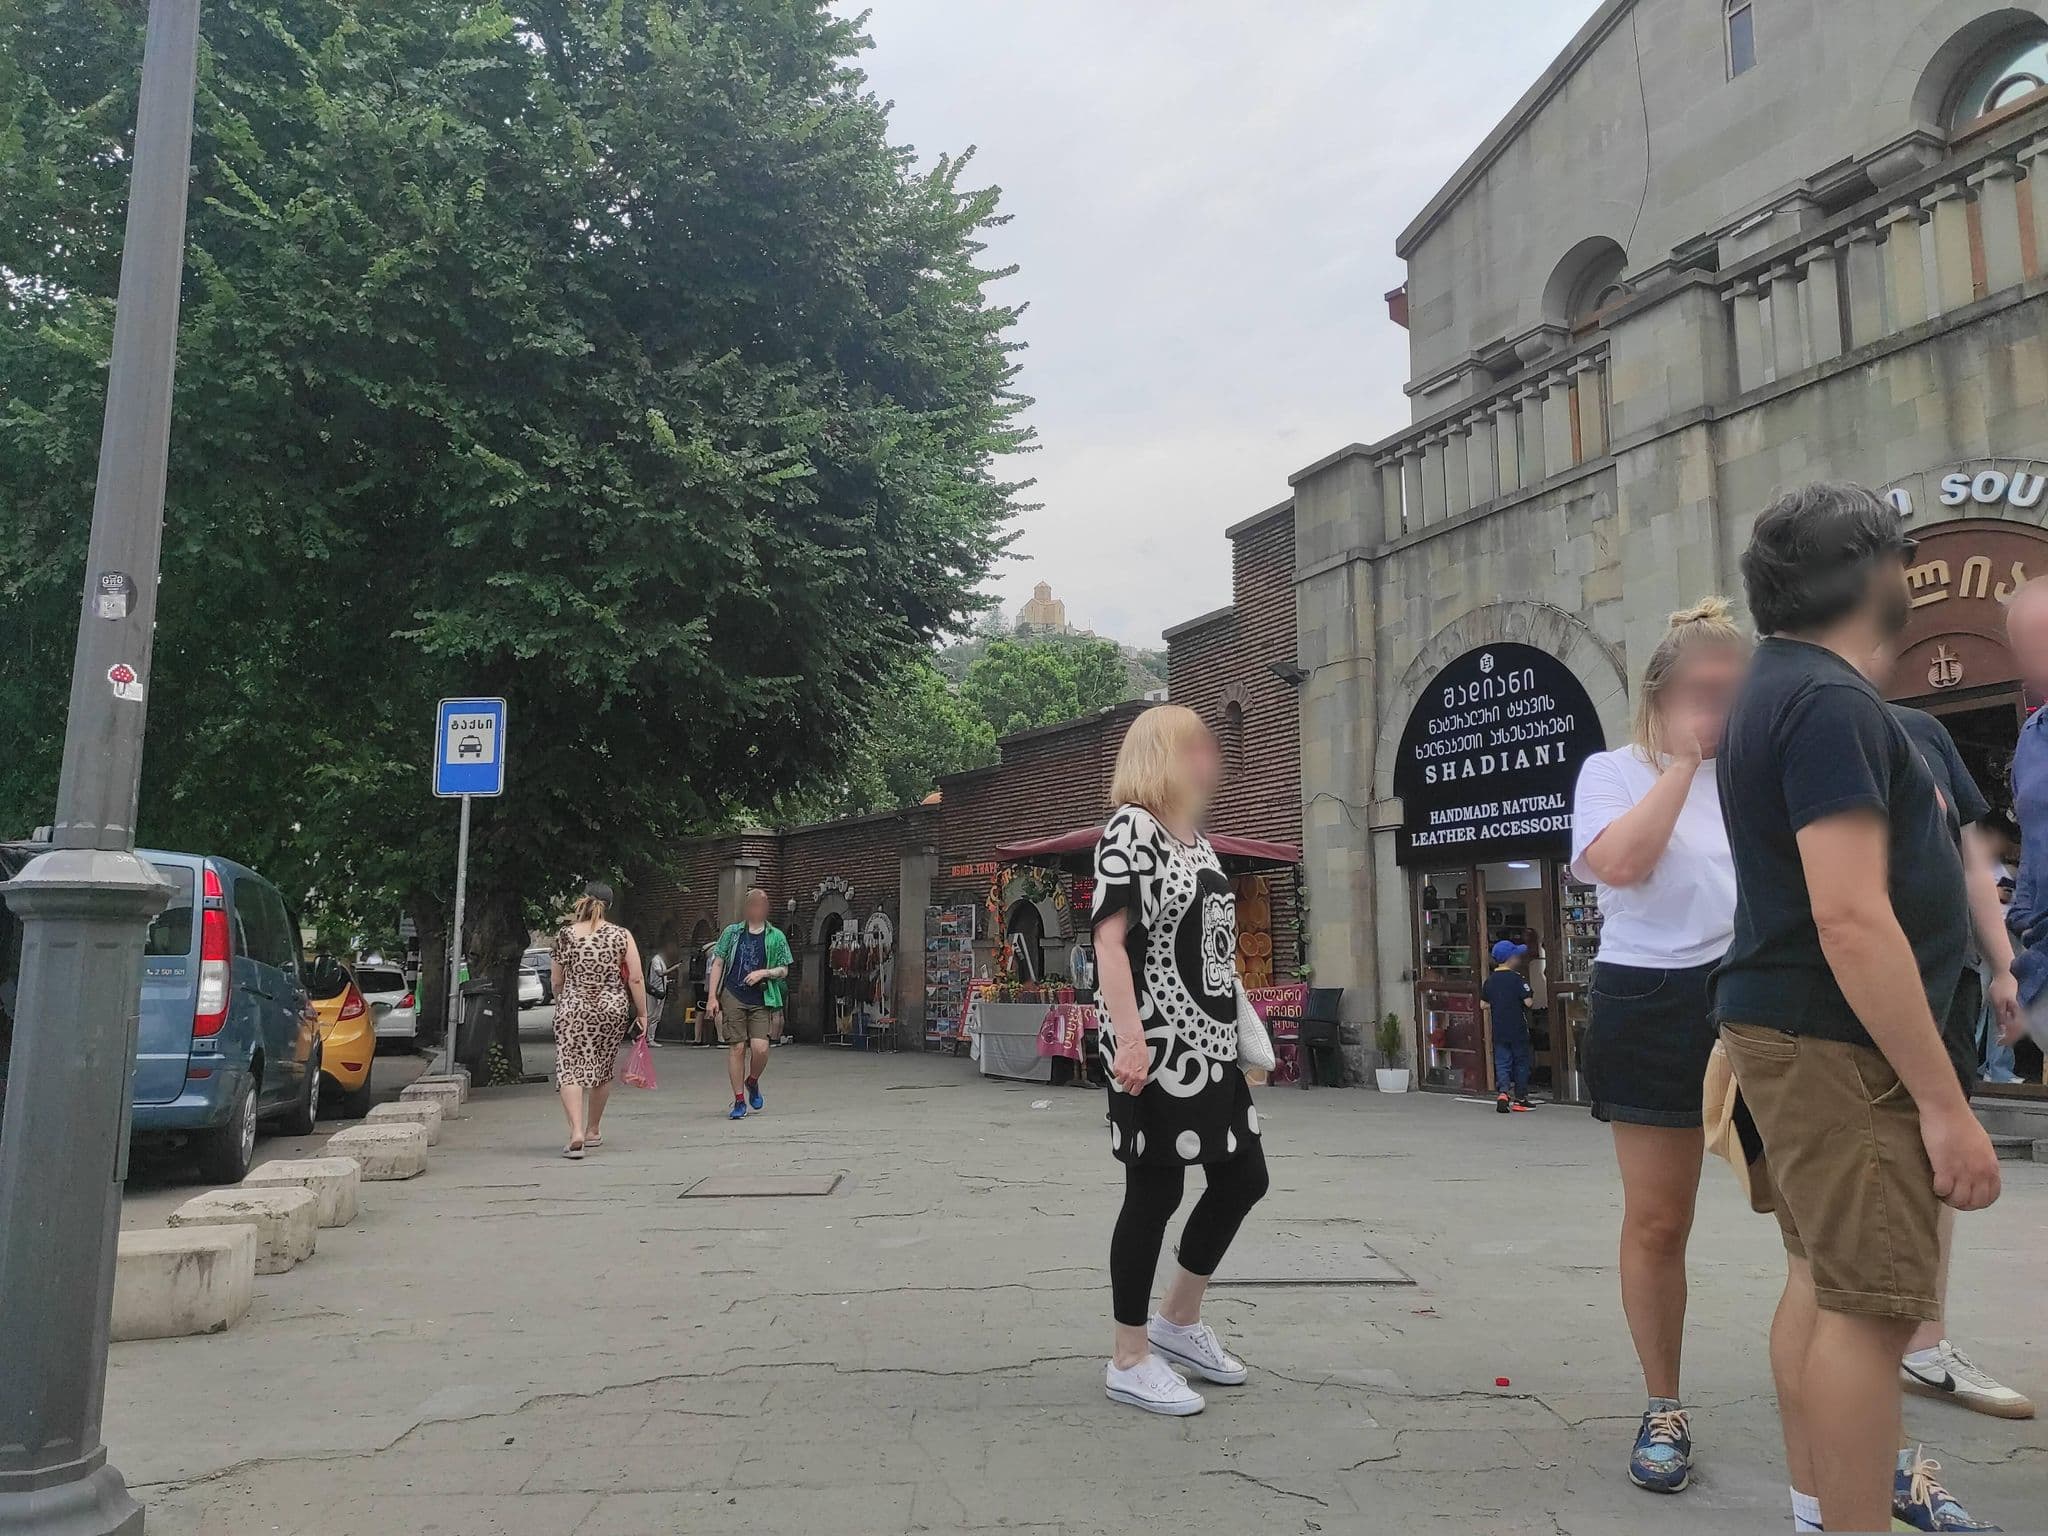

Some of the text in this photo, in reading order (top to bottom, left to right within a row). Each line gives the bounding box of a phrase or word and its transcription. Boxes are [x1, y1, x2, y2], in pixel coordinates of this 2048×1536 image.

[1444, 668, 1535, 708] შადიანი
[451, 719, 493, 730] ტაქსი
[1428, 694, 1555, 735] ნატურალური ტყავის
[1415, 714, 1575, 760] ხელნაკეთი აქსესუარები
[1425, 741, 1566, 784] SHADIANI
[1430, 792, 1566, 825] HANDMADE NATURAL
[1411, 826, 1477, 847] LEATHER
